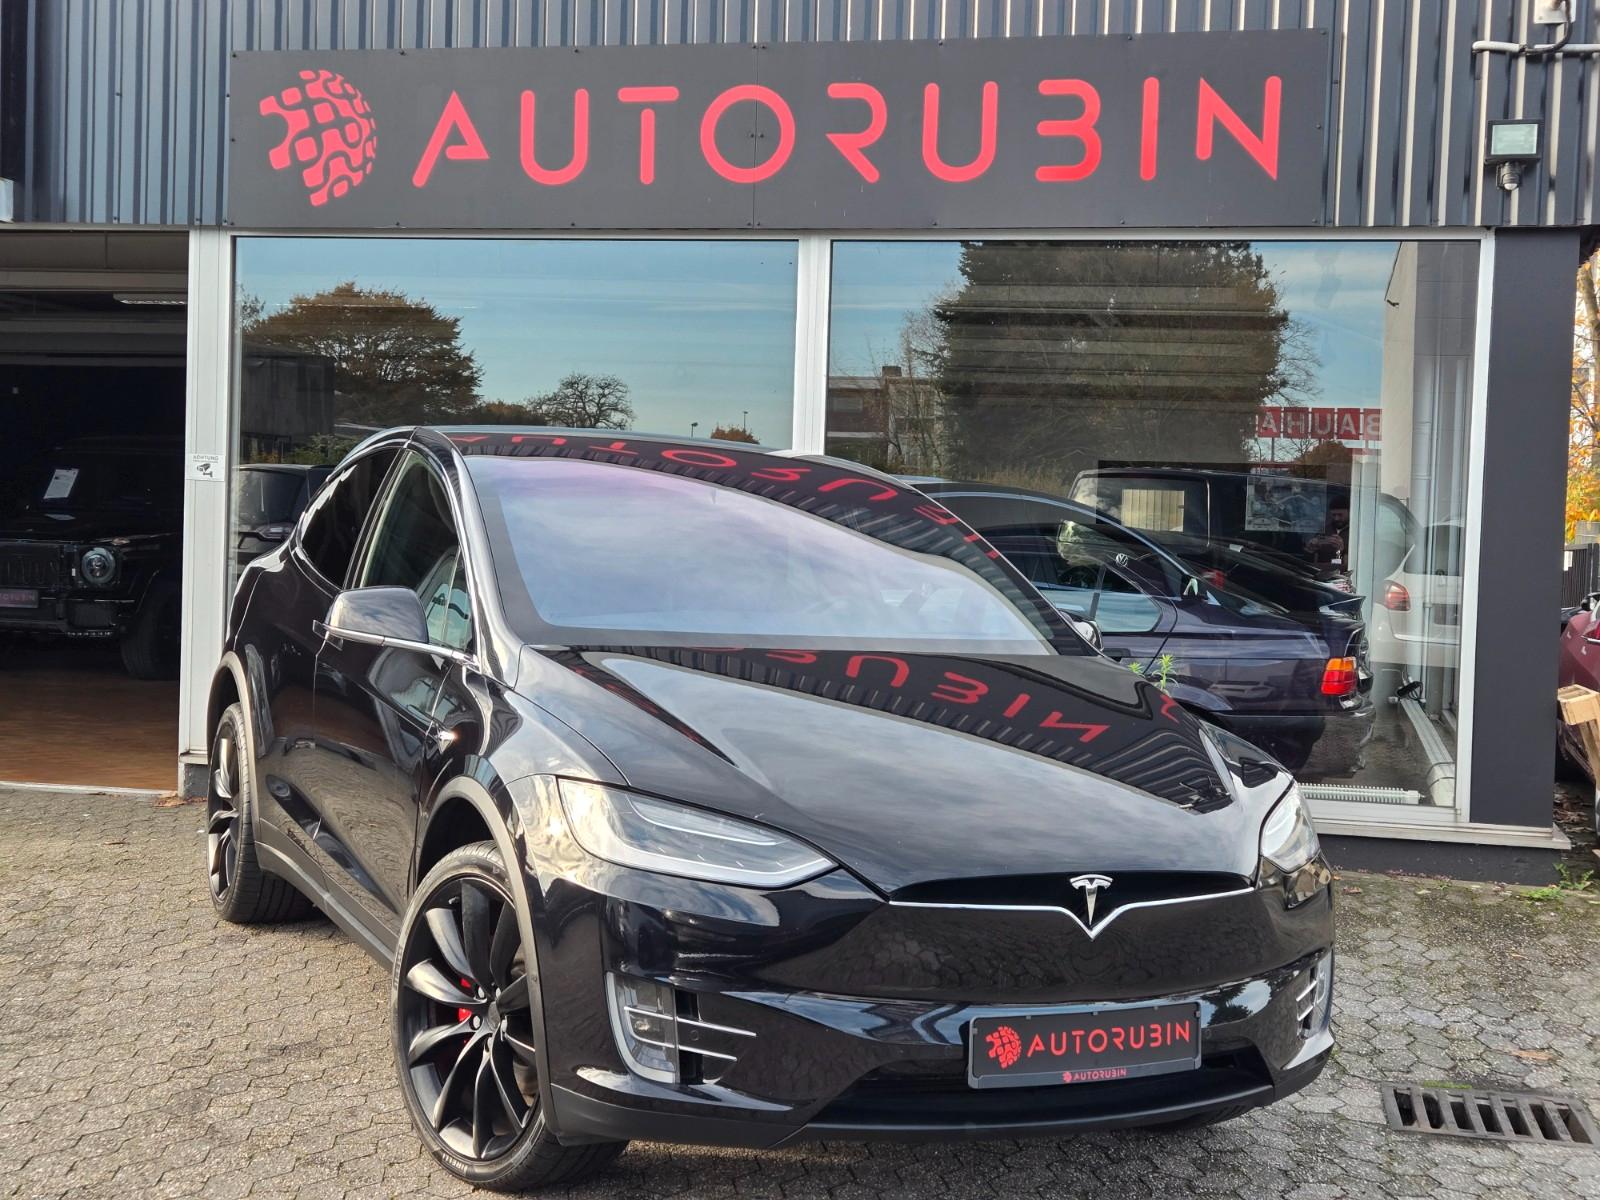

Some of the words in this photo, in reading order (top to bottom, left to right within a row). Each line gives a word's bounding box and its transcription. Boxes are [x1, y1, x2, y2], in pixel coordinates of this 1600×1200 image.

[412, 76, 1282, 188] AUTORUBIN
[1026, 1021, 1190, 1057] AUTORUBIN
[1072, 1068, 1127, 1081] AUTORUBIN
